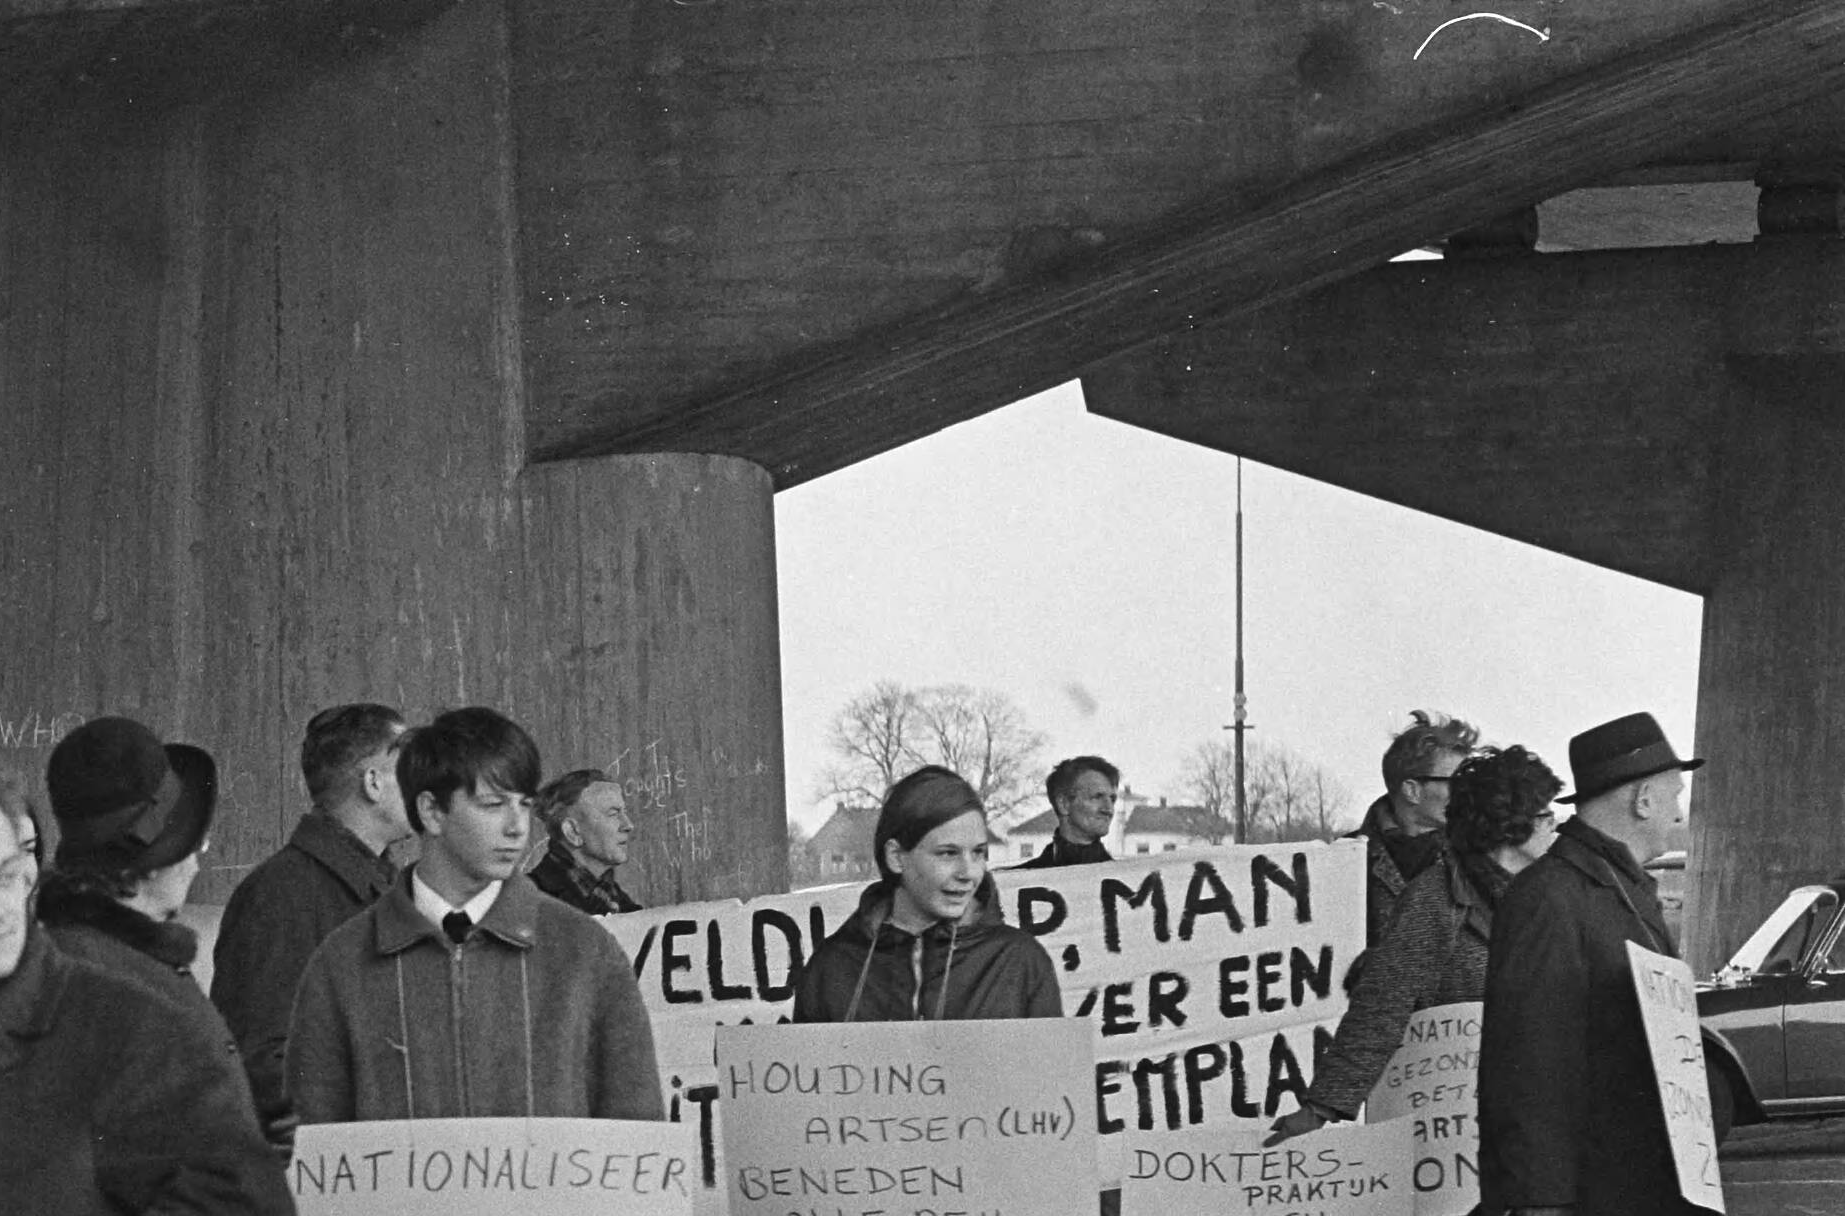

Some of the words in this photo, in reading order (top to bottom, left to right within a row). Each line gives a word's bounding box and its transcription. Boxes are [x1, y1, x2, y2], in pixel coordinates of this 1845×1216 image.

[1101, 852, 1312, 953] MAN
[1219, 945, 1333, 1018] EEN
[730, 1062, 947, 1099] HOUDING
[295, 1146, 689, 1197] NATIONALISEER
[738, 1165, 965, 1201] BENEDEN
[1129, 1148, 1364, 1184] DOKTERS-
